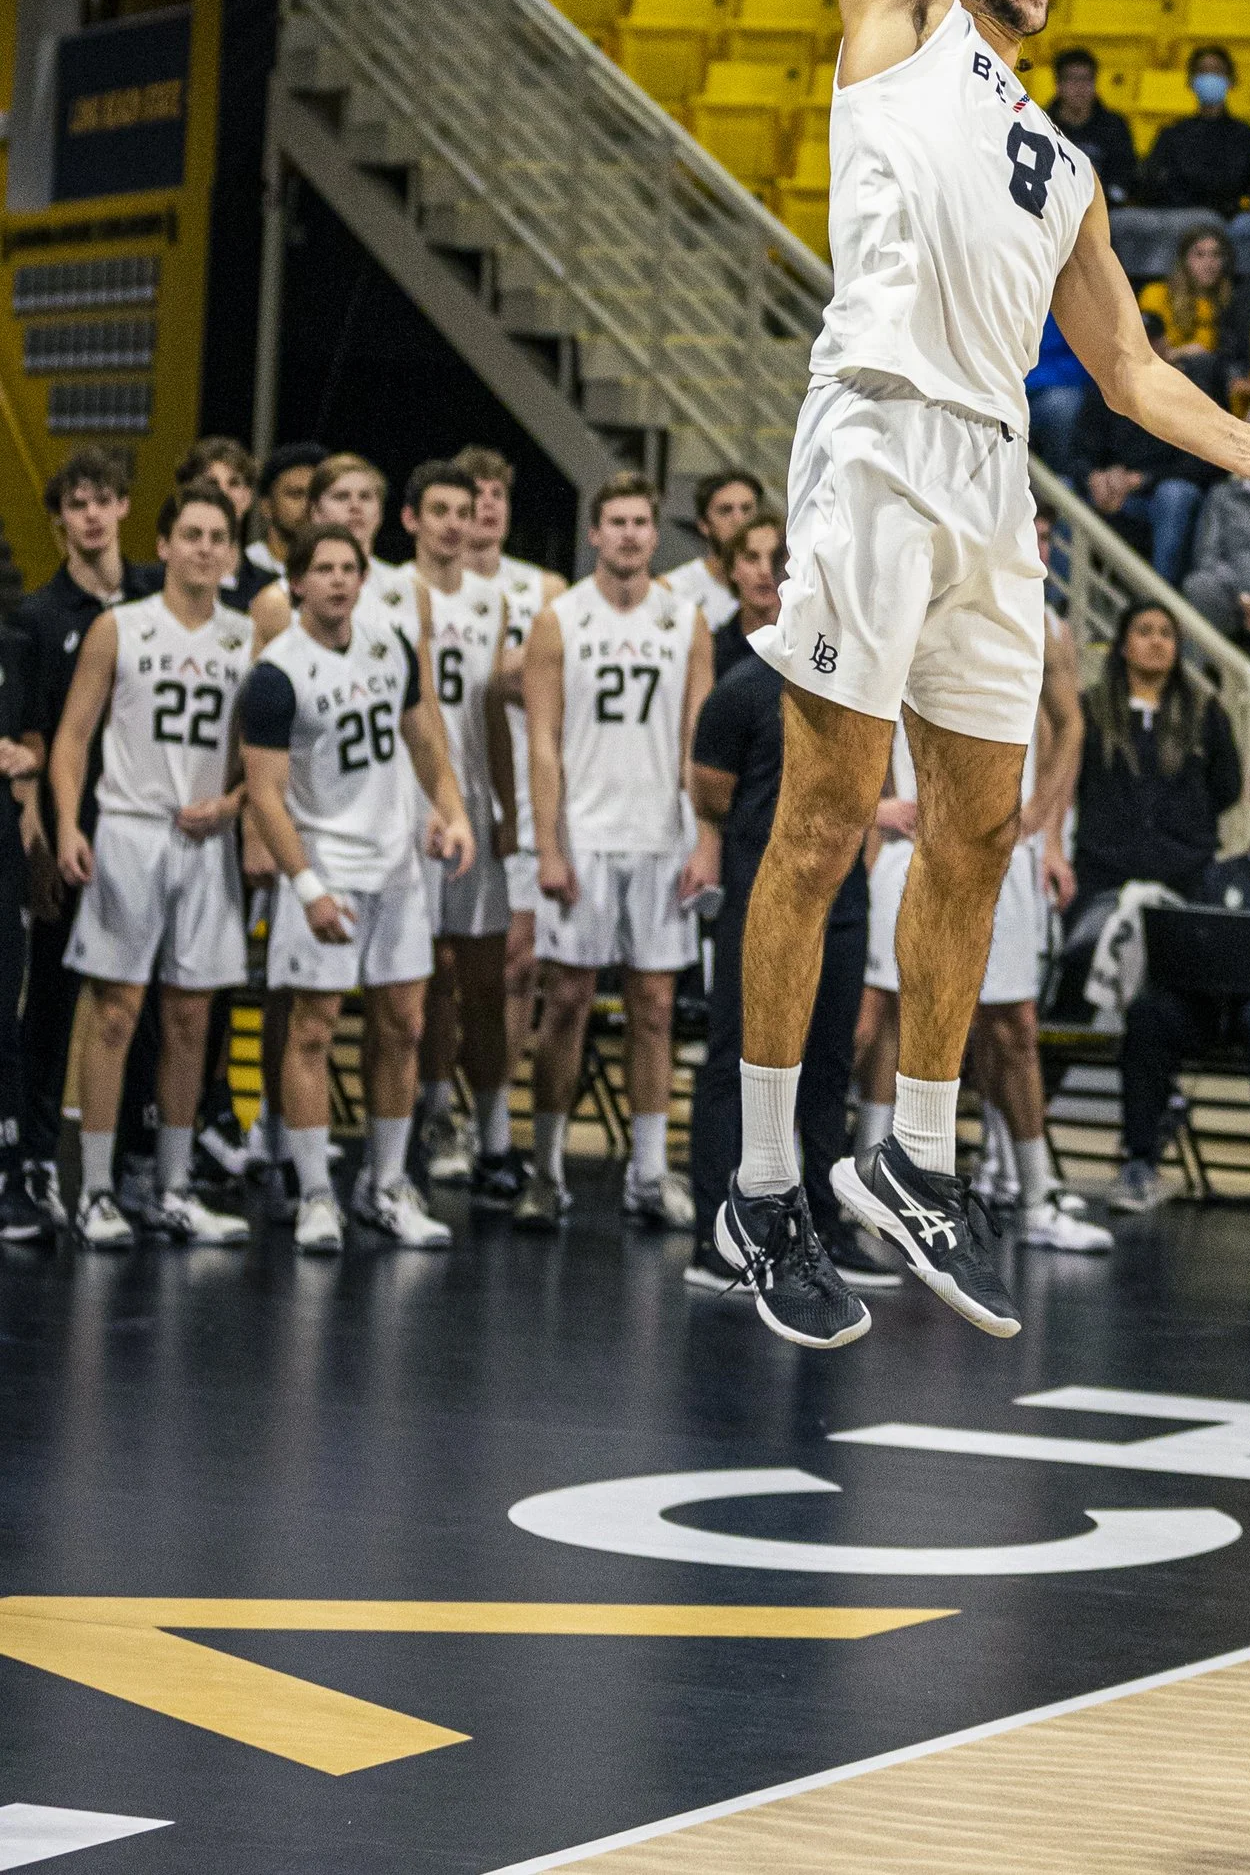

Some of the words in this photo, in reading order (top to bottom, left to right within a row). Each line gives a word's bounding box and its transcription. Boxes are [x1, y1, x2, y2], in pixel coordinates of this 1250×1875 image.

[1006, 121, 1056, 220] 8
[138, 653, 239, 684] BEACH
[580, 639, 674, 662] BEACH
[153, 679, 224, 749] 22
[316, 674, 398, 714] BEACH
[596, 664, 661, 725] 27
[336, 701, 395, 773] 26
